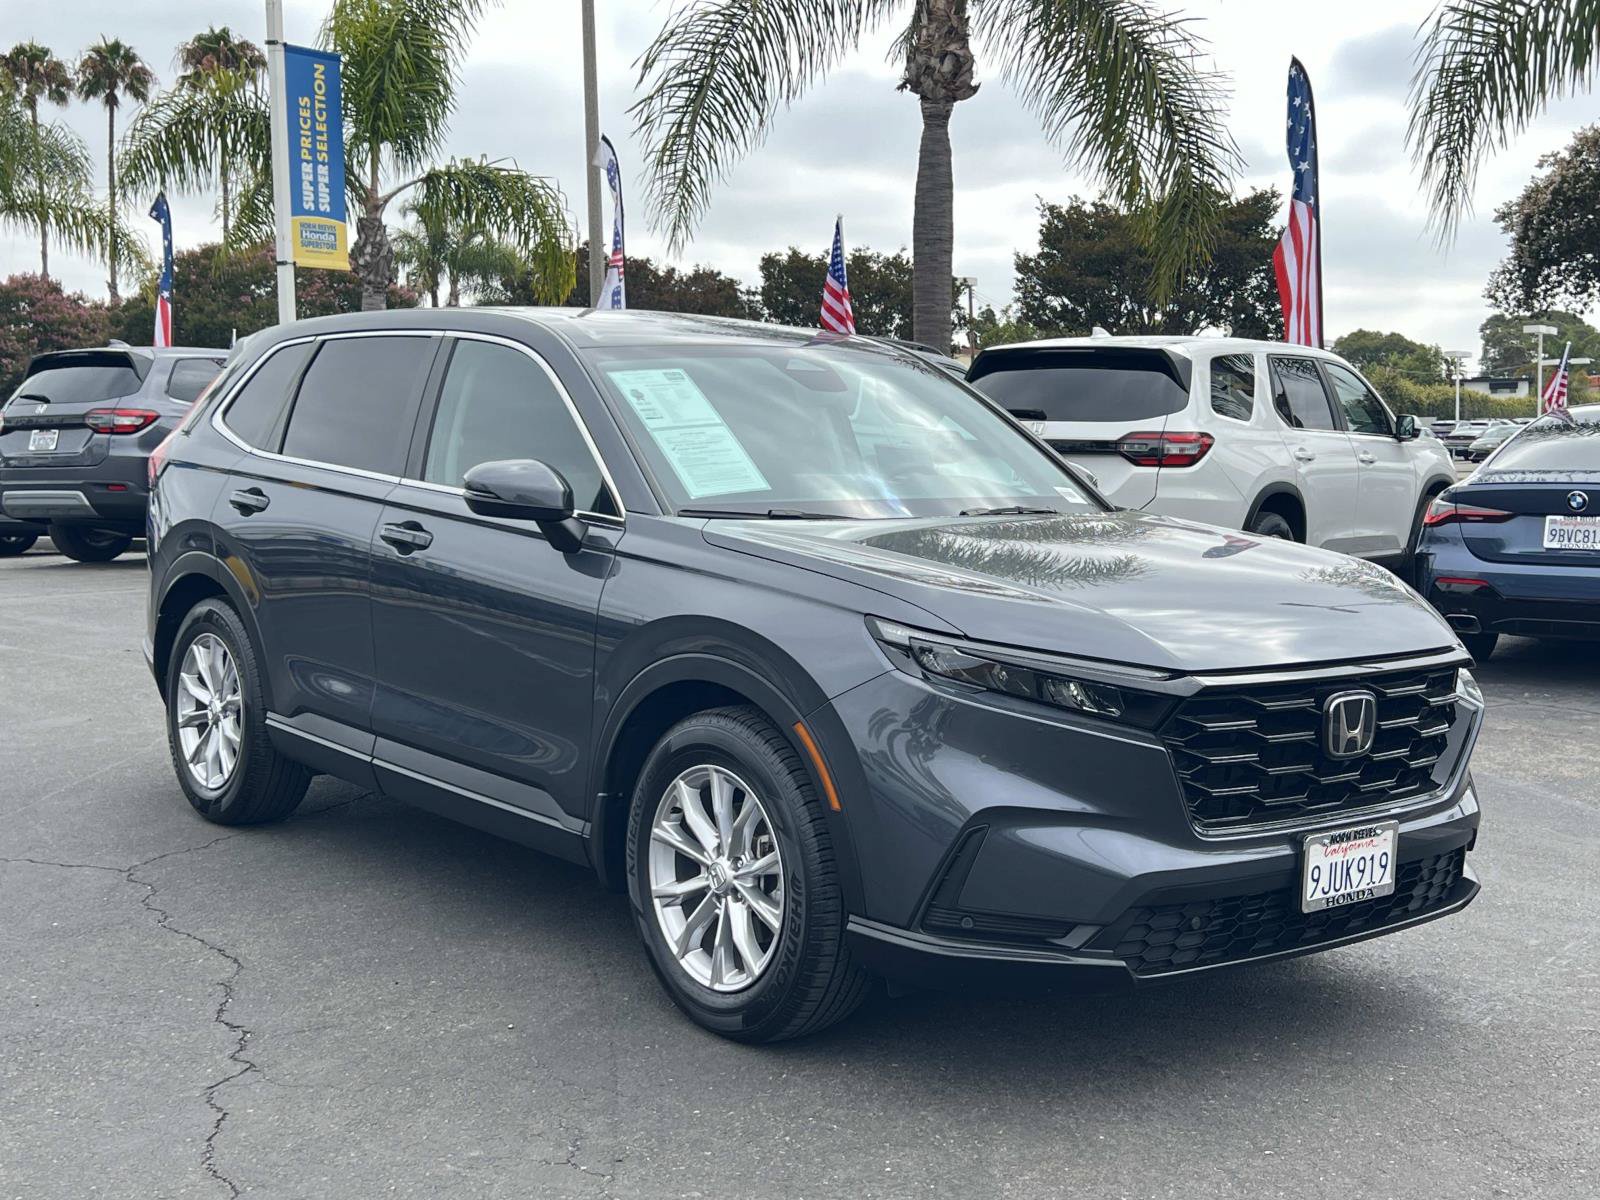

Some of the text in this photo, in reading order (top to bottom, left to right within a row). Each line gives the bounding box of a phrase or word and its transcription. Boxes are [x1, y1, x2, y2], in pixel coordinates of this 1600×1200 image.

[314, 64, 330, 212] SUPER SELECTION
[299, 96, 315, 211] SUPER PRICES
[302, 230, 335, 240] Honda
[1549, 528, 1600, 543] 9BVC81
[1353, 827, 1377, 840] REEVES
[1324, 840, 1377, 858] California
[1310, 851, 1389, 898] 9JUK919
[1326, 888, 1375, 907] HONDA
